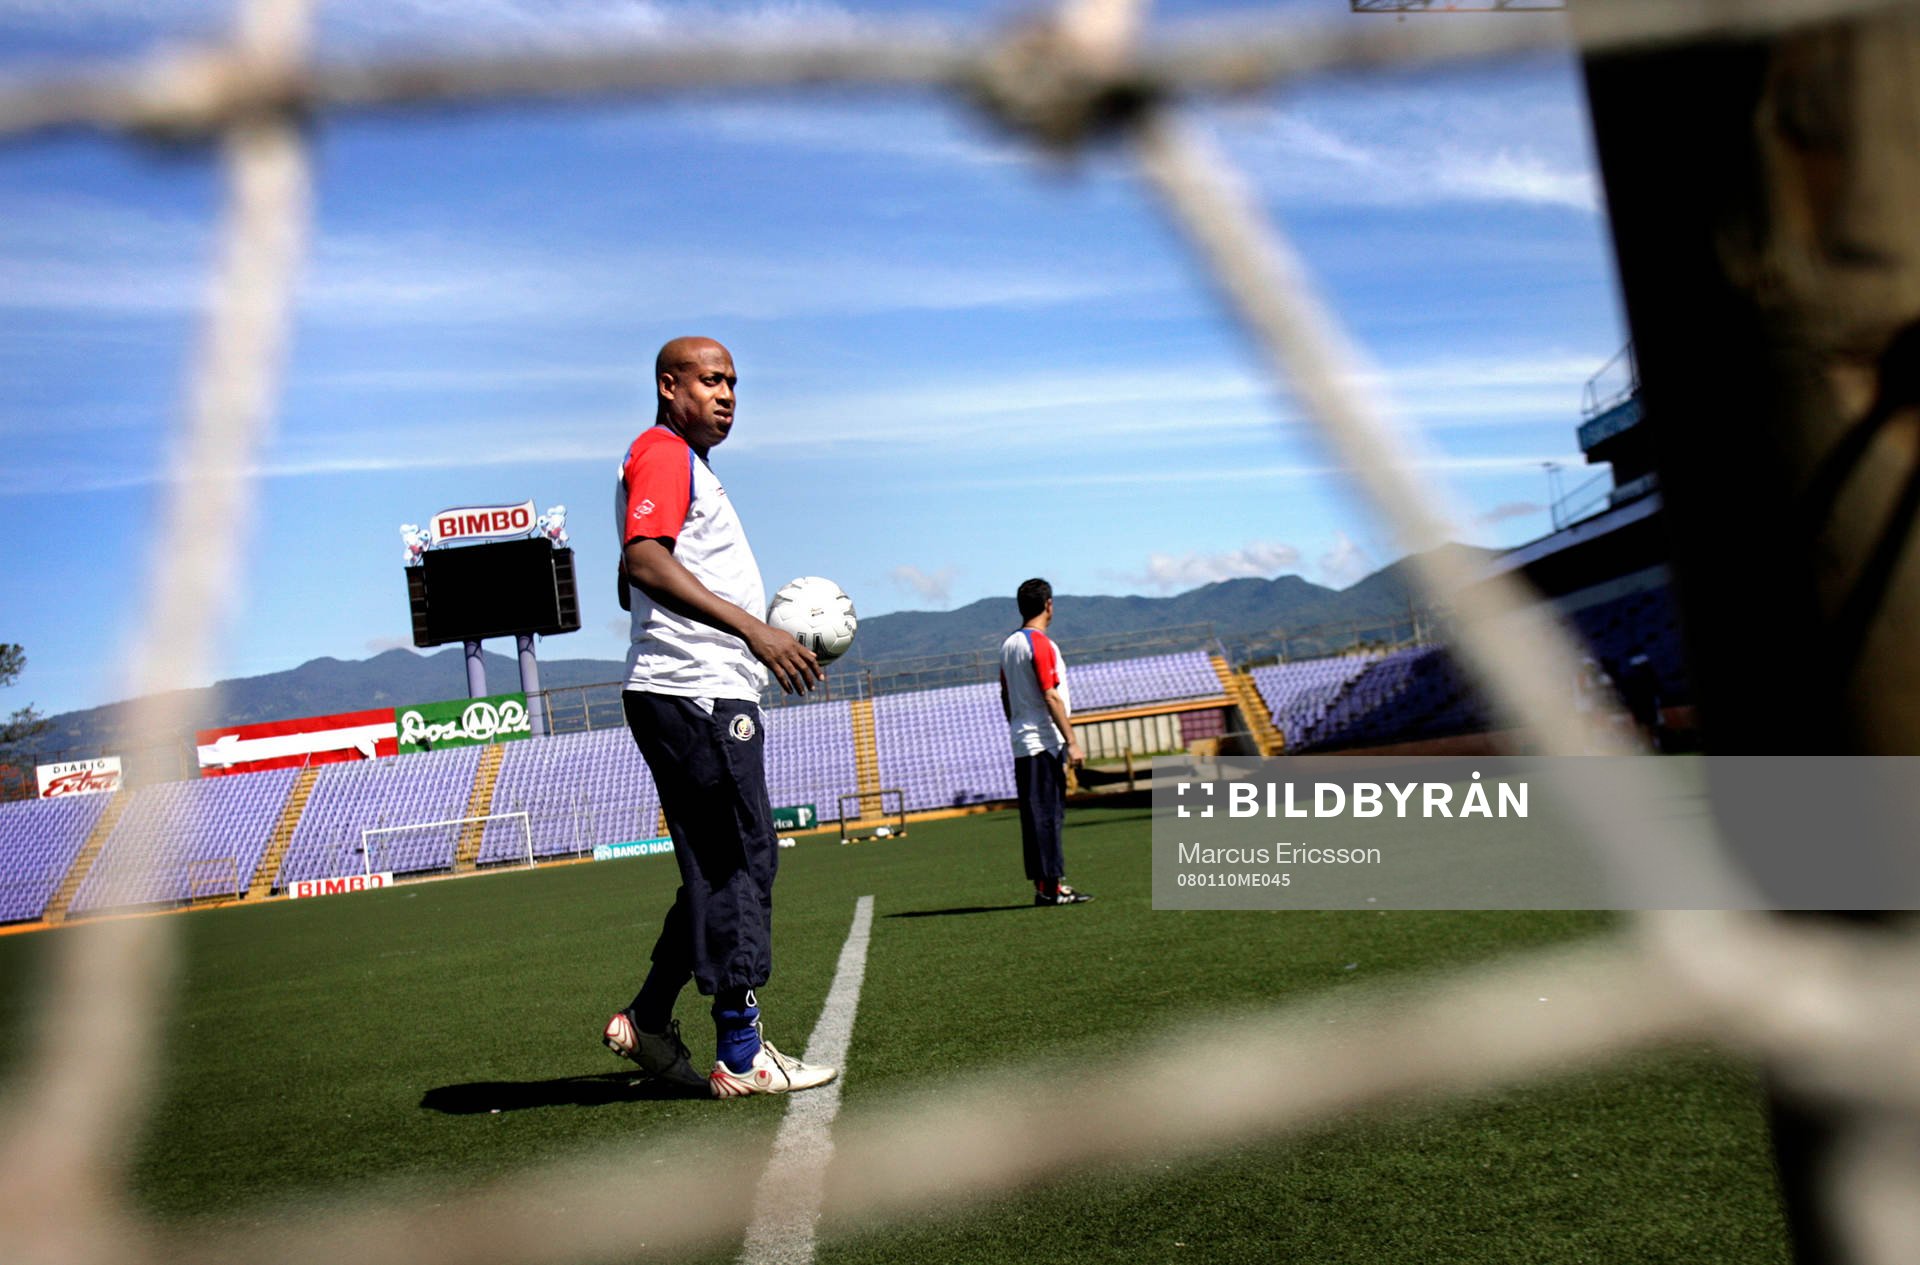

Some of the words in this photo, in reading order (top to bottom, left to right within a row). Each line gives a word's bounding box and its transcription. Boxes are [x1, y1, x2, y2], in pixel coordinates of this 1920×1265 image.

[438, 508, 529, 538] BIMBO
[400, 711, 467, 745] Dos
[53, 760, 105, 774] DIARIO
[43, 769, 119, 798] Extra
[613, 844, 648, 858] BANCO
[298, 875, 383, 899] BIMBO
